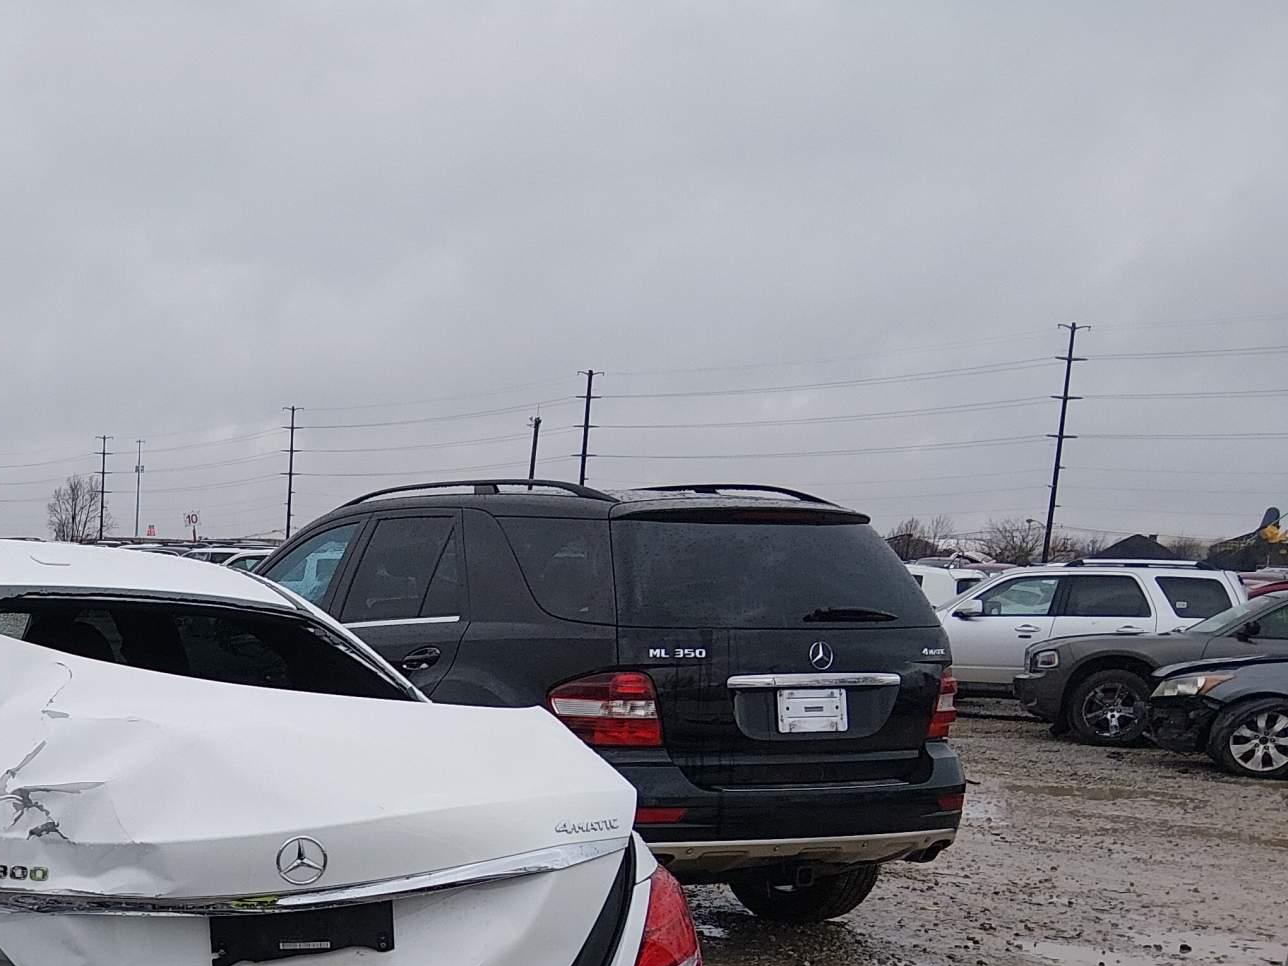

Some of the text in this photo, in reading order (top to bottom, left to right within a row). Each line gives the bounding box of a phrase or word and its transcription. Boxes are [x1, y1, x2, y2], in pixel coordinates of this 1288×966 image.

[185, 513, 198, 525] 10
[648, 648, 707, 658] ML 350
